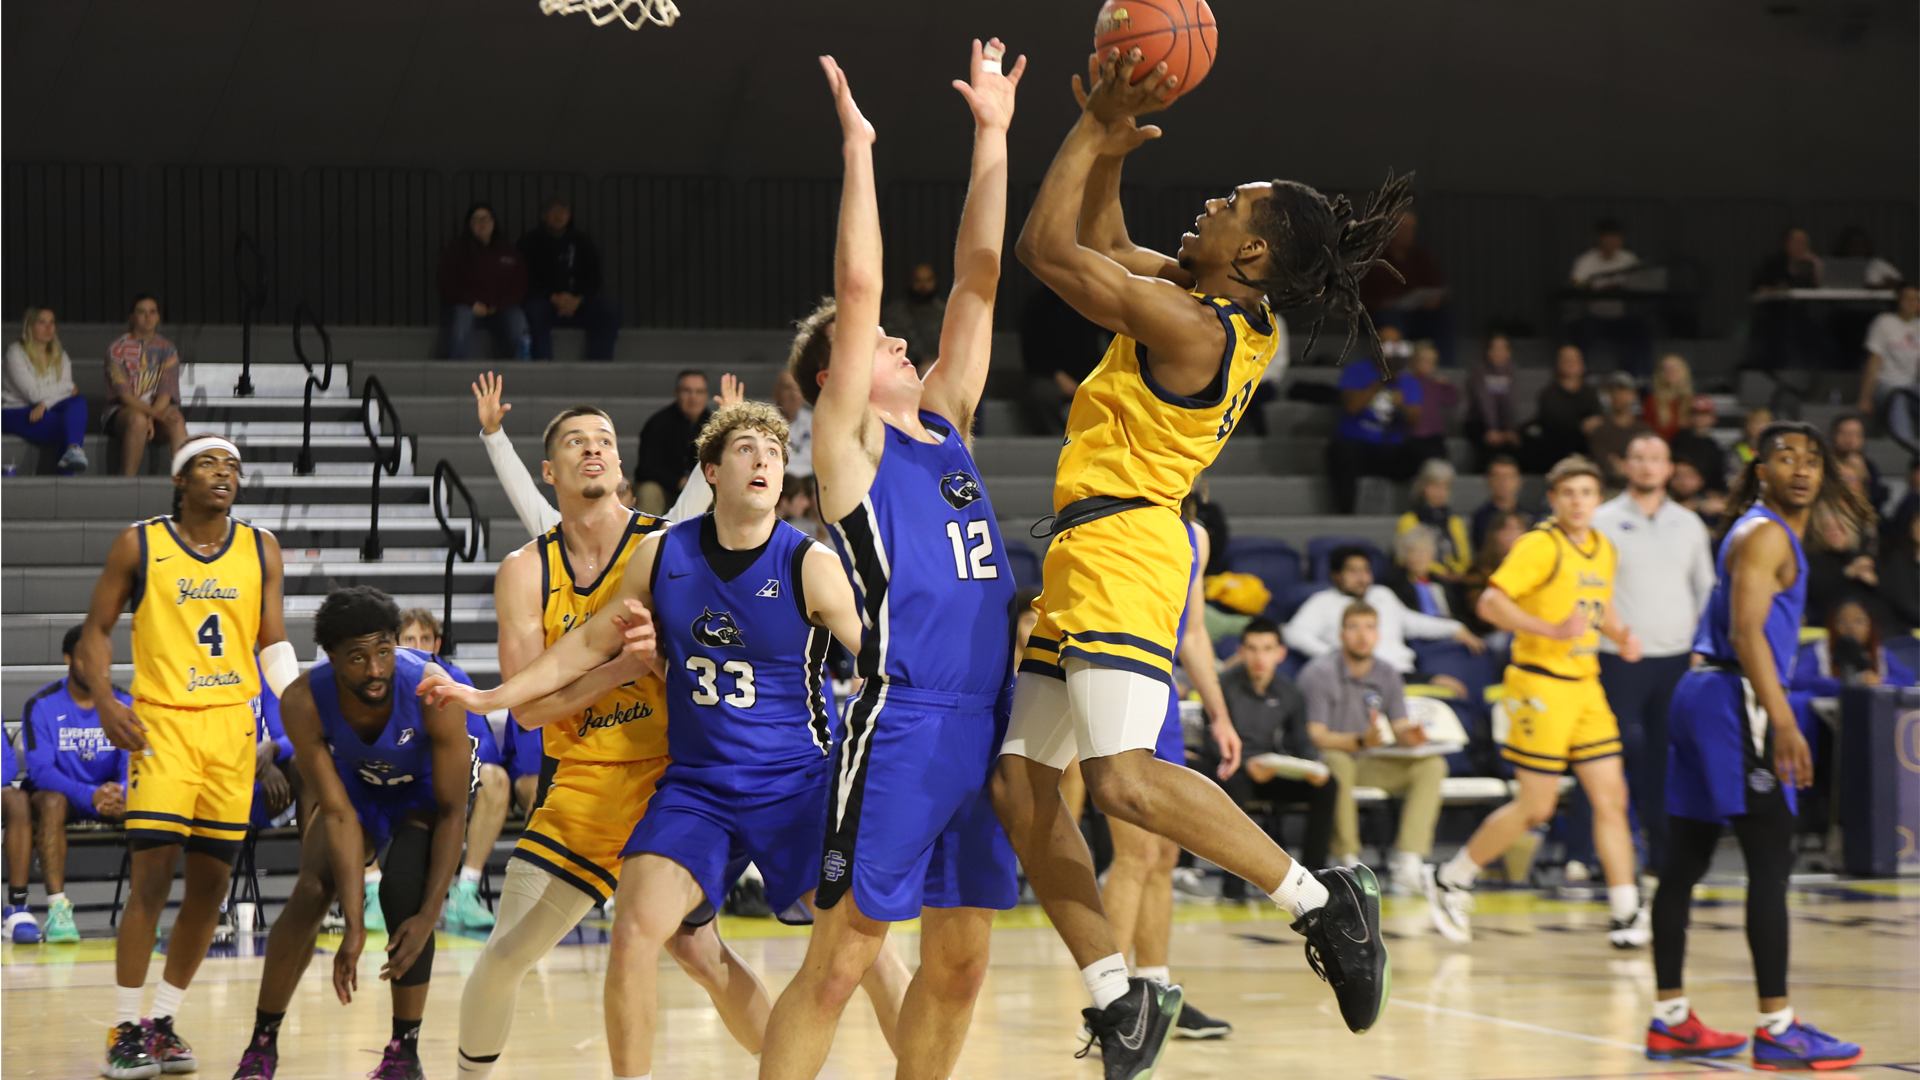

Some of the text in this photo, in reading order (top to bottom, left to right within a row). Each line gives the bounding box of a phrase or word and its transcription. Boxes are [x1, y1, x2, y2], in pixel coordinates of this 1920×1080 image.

[944, 518, 999, 581] 12
[176, 578, 240, 605] Yellow
[196, 612, 225, 657] 4
[186, 667, 243, 692] Jackets
[685, 655, 758, 710] 33
[577, 701, 654, 738] Jackets
